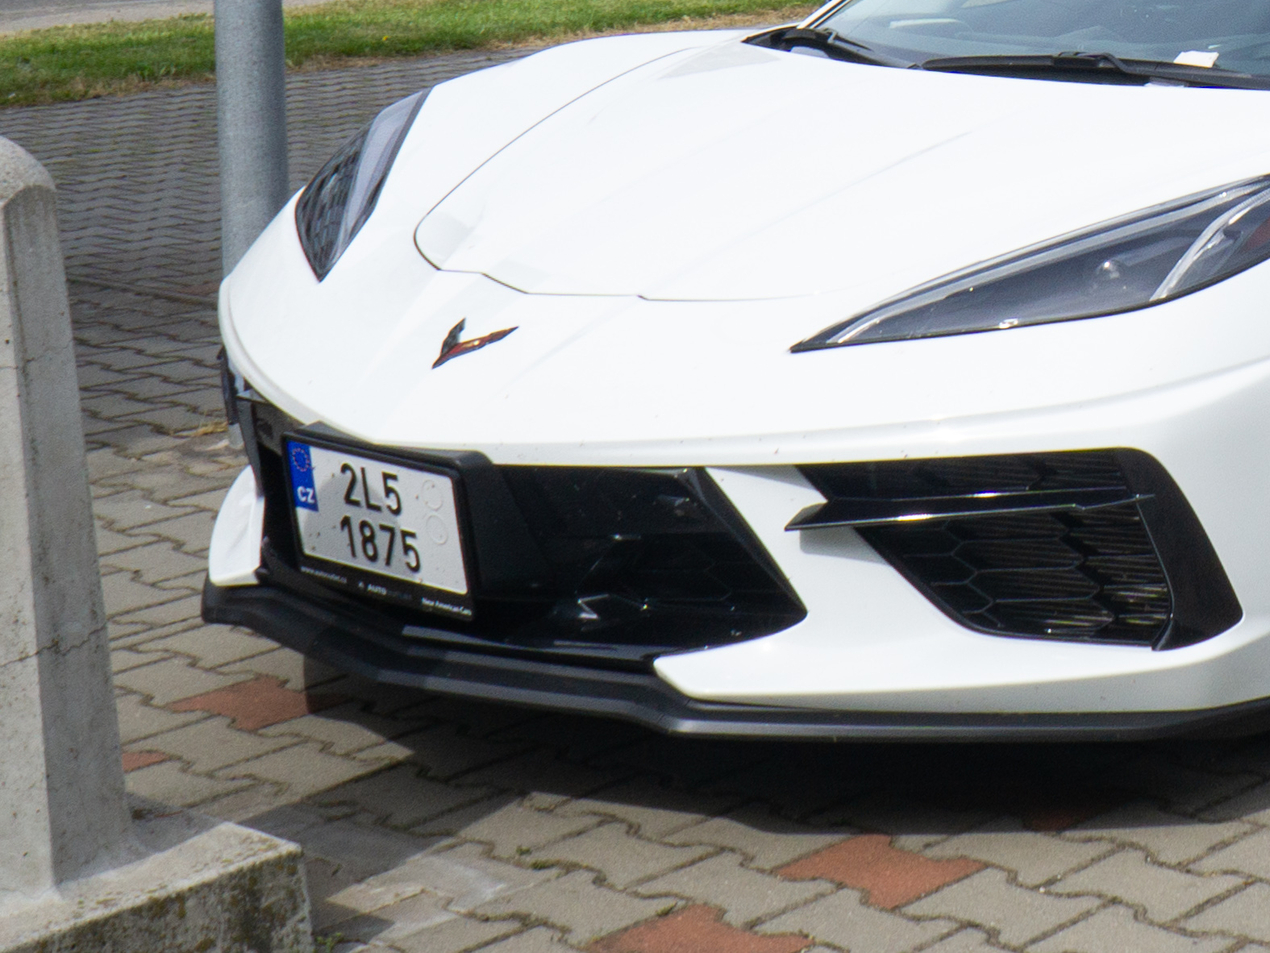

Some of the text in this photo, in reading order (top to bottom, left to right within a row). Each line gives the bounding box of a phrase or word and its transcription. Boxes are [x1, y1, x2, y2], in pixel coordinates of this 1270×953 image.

[297, 486, 315, 504] CZ
[340, 462, 402, 517] 2L5
[340, 515, 421, 574] 1875
